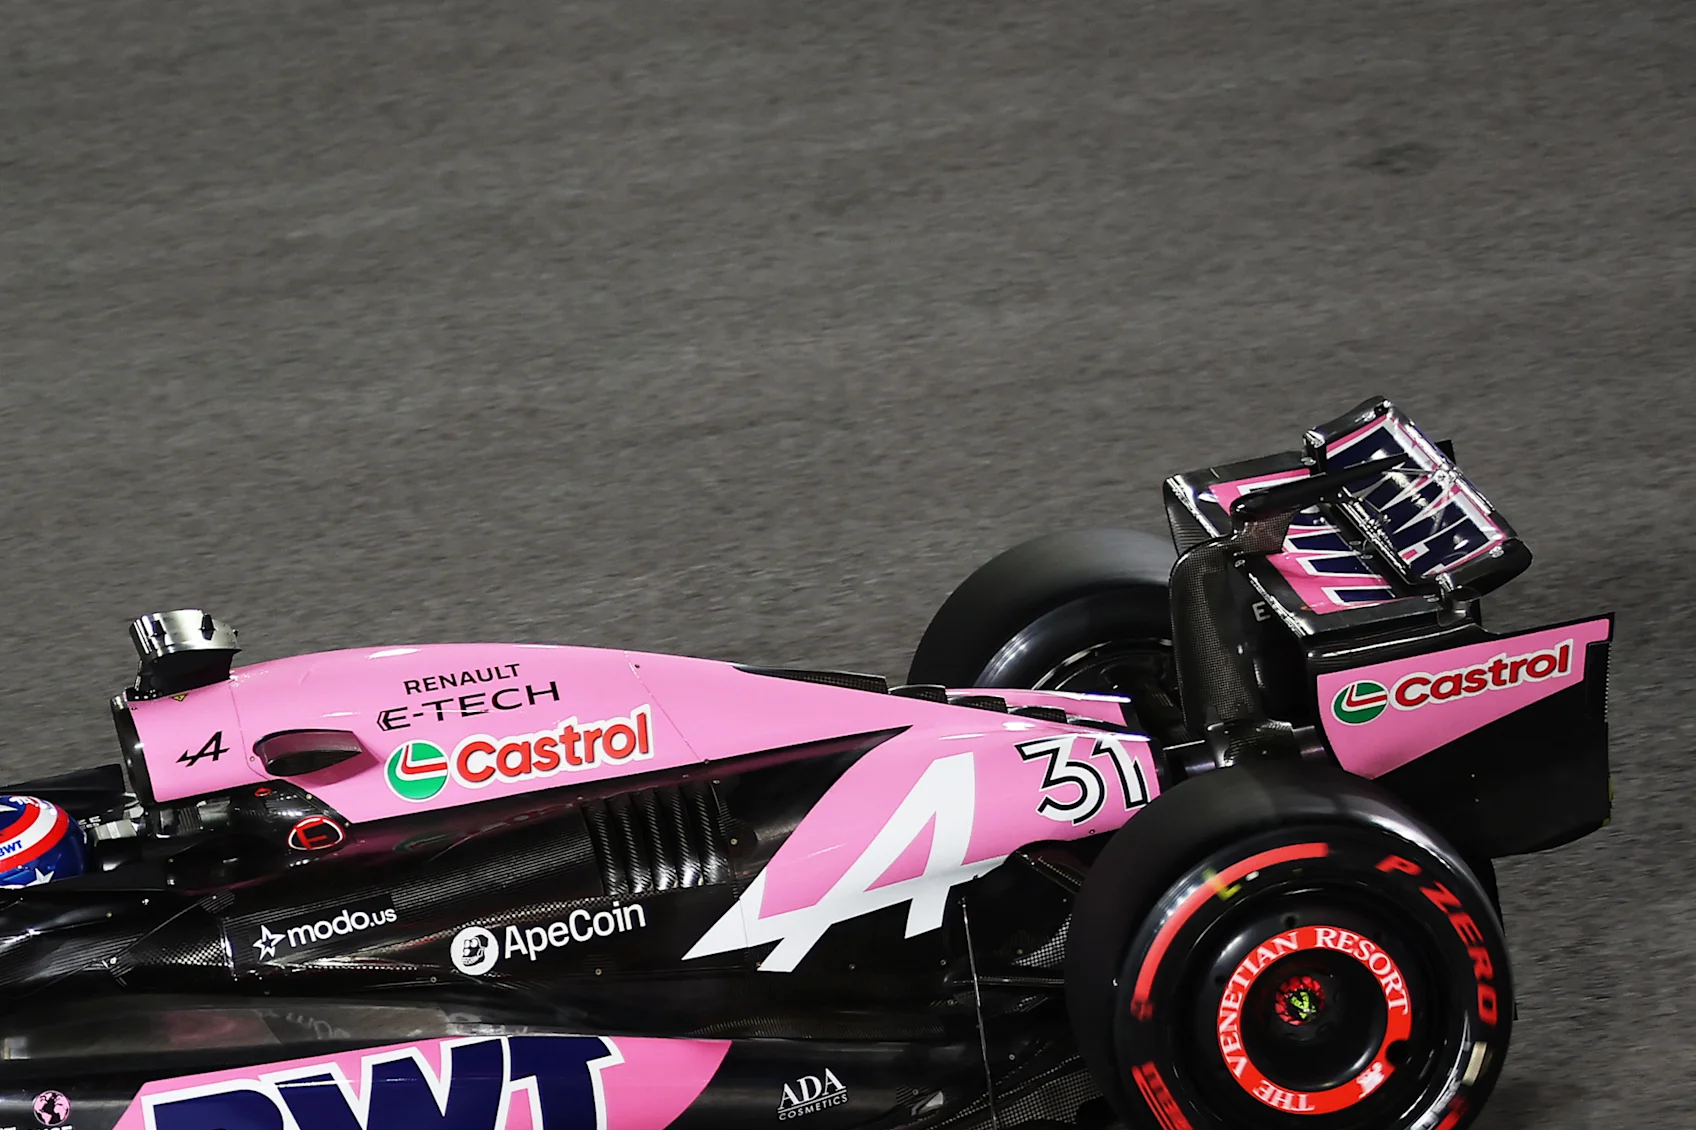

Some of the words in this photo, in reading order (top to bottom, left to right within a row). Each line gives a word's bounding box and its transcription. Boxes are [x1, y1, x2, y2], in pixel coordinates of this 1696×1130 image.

[376, 681, 561, 731] E-TECH
[403, 663, 521, 695] RENAULT
[1394, 643, 1571, 707] Castrol
[455, 711, 650, 783] Castrol
[1014, 733, 1151, 827] 31
[287, 906, 398, 949] modo.us
[504, 899, 647, 961] ApeCoin
[1375, 854, 1423, 877] P
[1418, 880, 1499, 1026] ZERO
[1313, 927, 1411, 1016] RESORT
[1218, 930, 1301, 1078] VENETIAN
[777, 1067, 847, 1111] ADA
[778, 1093, 849, 1121] COSMETICS
[1252, 1079, 1316, 1114] THE
